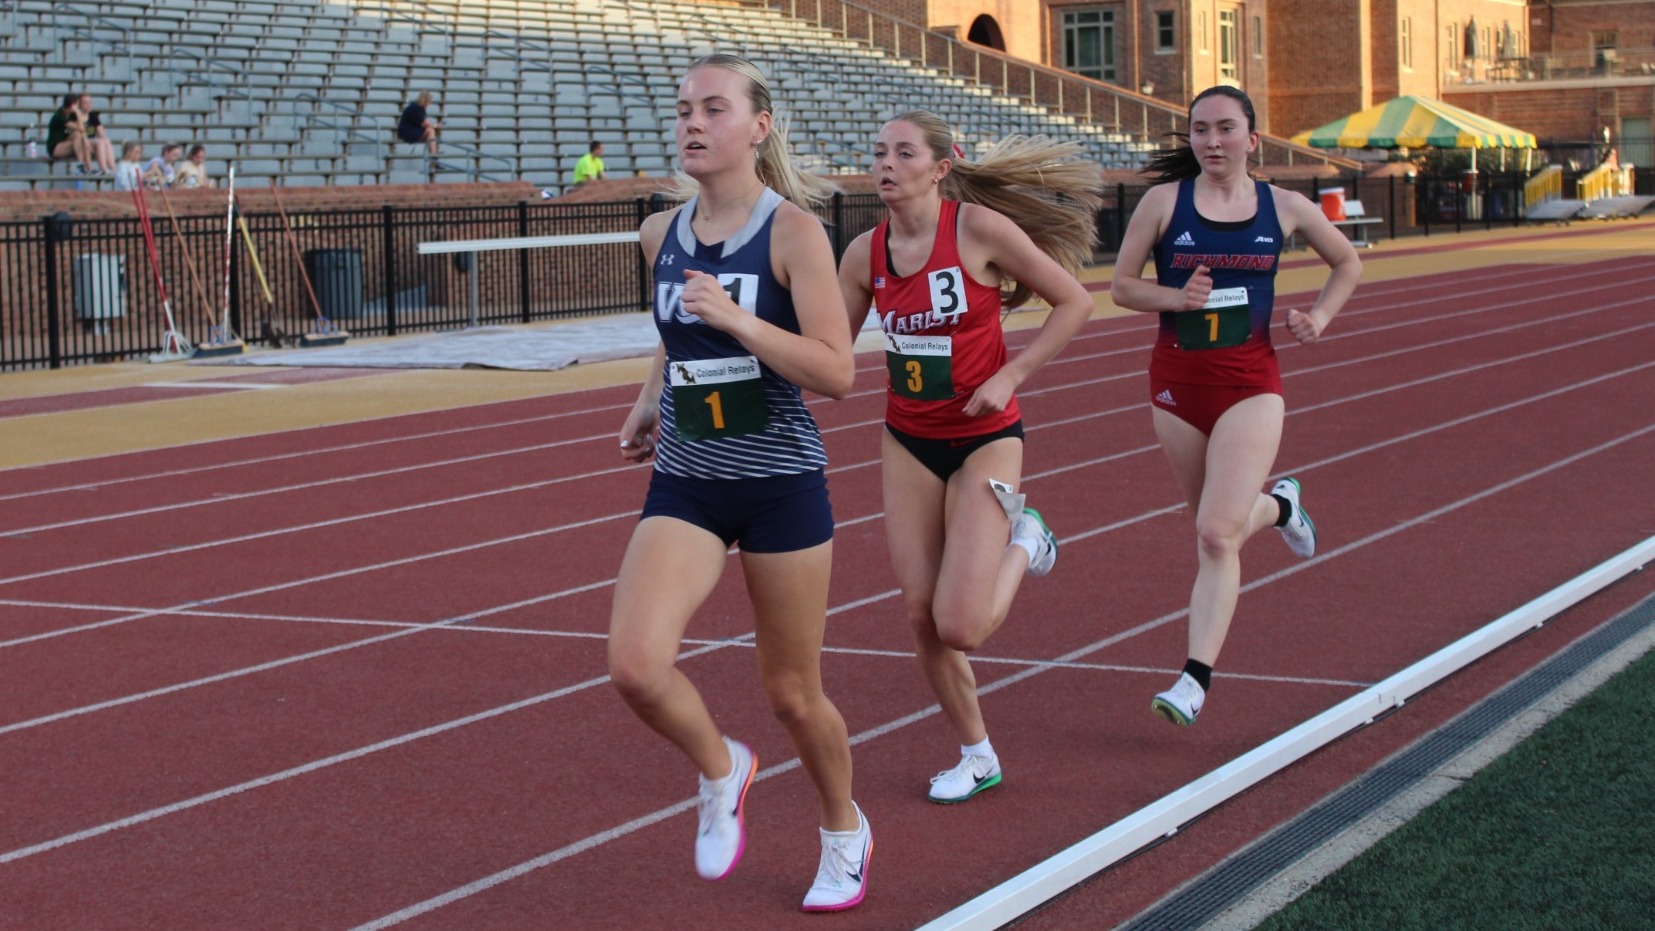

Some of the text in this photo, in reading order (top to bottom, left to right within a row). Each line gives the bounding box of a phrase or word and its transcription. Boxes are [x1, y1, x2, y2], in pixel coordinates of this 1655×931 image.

[1170, 254, 1275, 270] RICHMOND
[722, 277, 742, 306] 1
[935, 271, 959, 314] 3
[1224, 294, 1245, 302] Relays
[1204, 312, 1219, 342] 1
[901, 341, 948, 352] Colonial Relays
[696, 365, 755, 378] Colonial Relays
[905, 360, 922, 392] 3
[704, 391, 726, 429] 1
